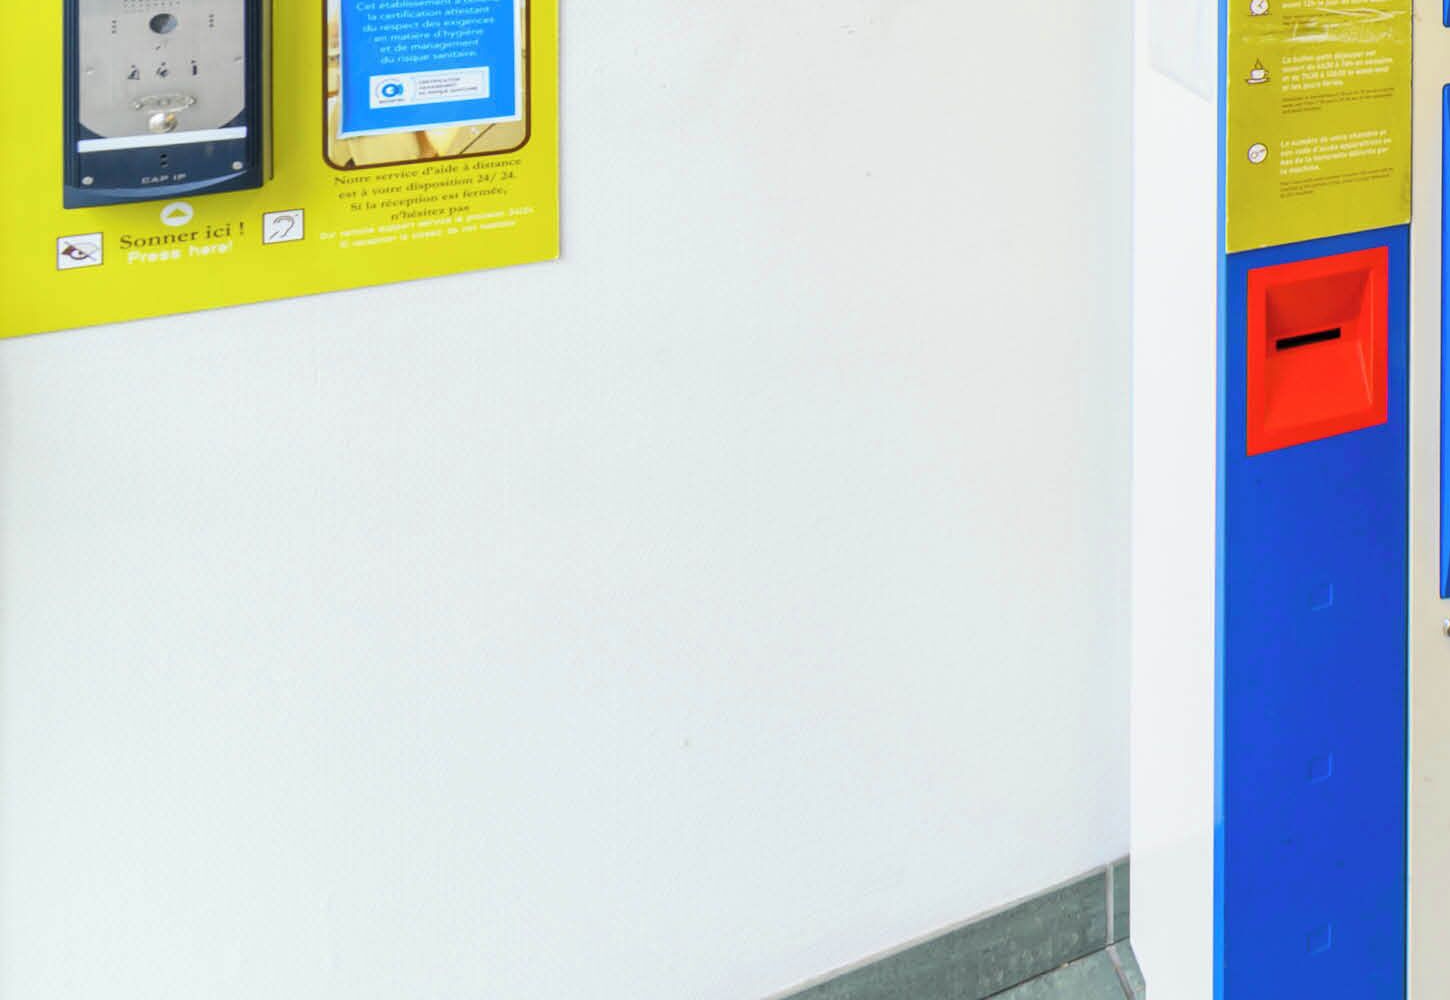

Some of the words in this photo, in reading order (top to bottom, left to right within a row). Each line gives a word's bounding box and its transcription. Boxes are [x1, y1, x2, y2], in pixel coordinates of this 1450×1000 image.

[120, 231, 196, 249] Sonner
[205, 225, 231, 241] ici
[127, 249, 181, 264] Press
[189, 241, 233, 259] here!
